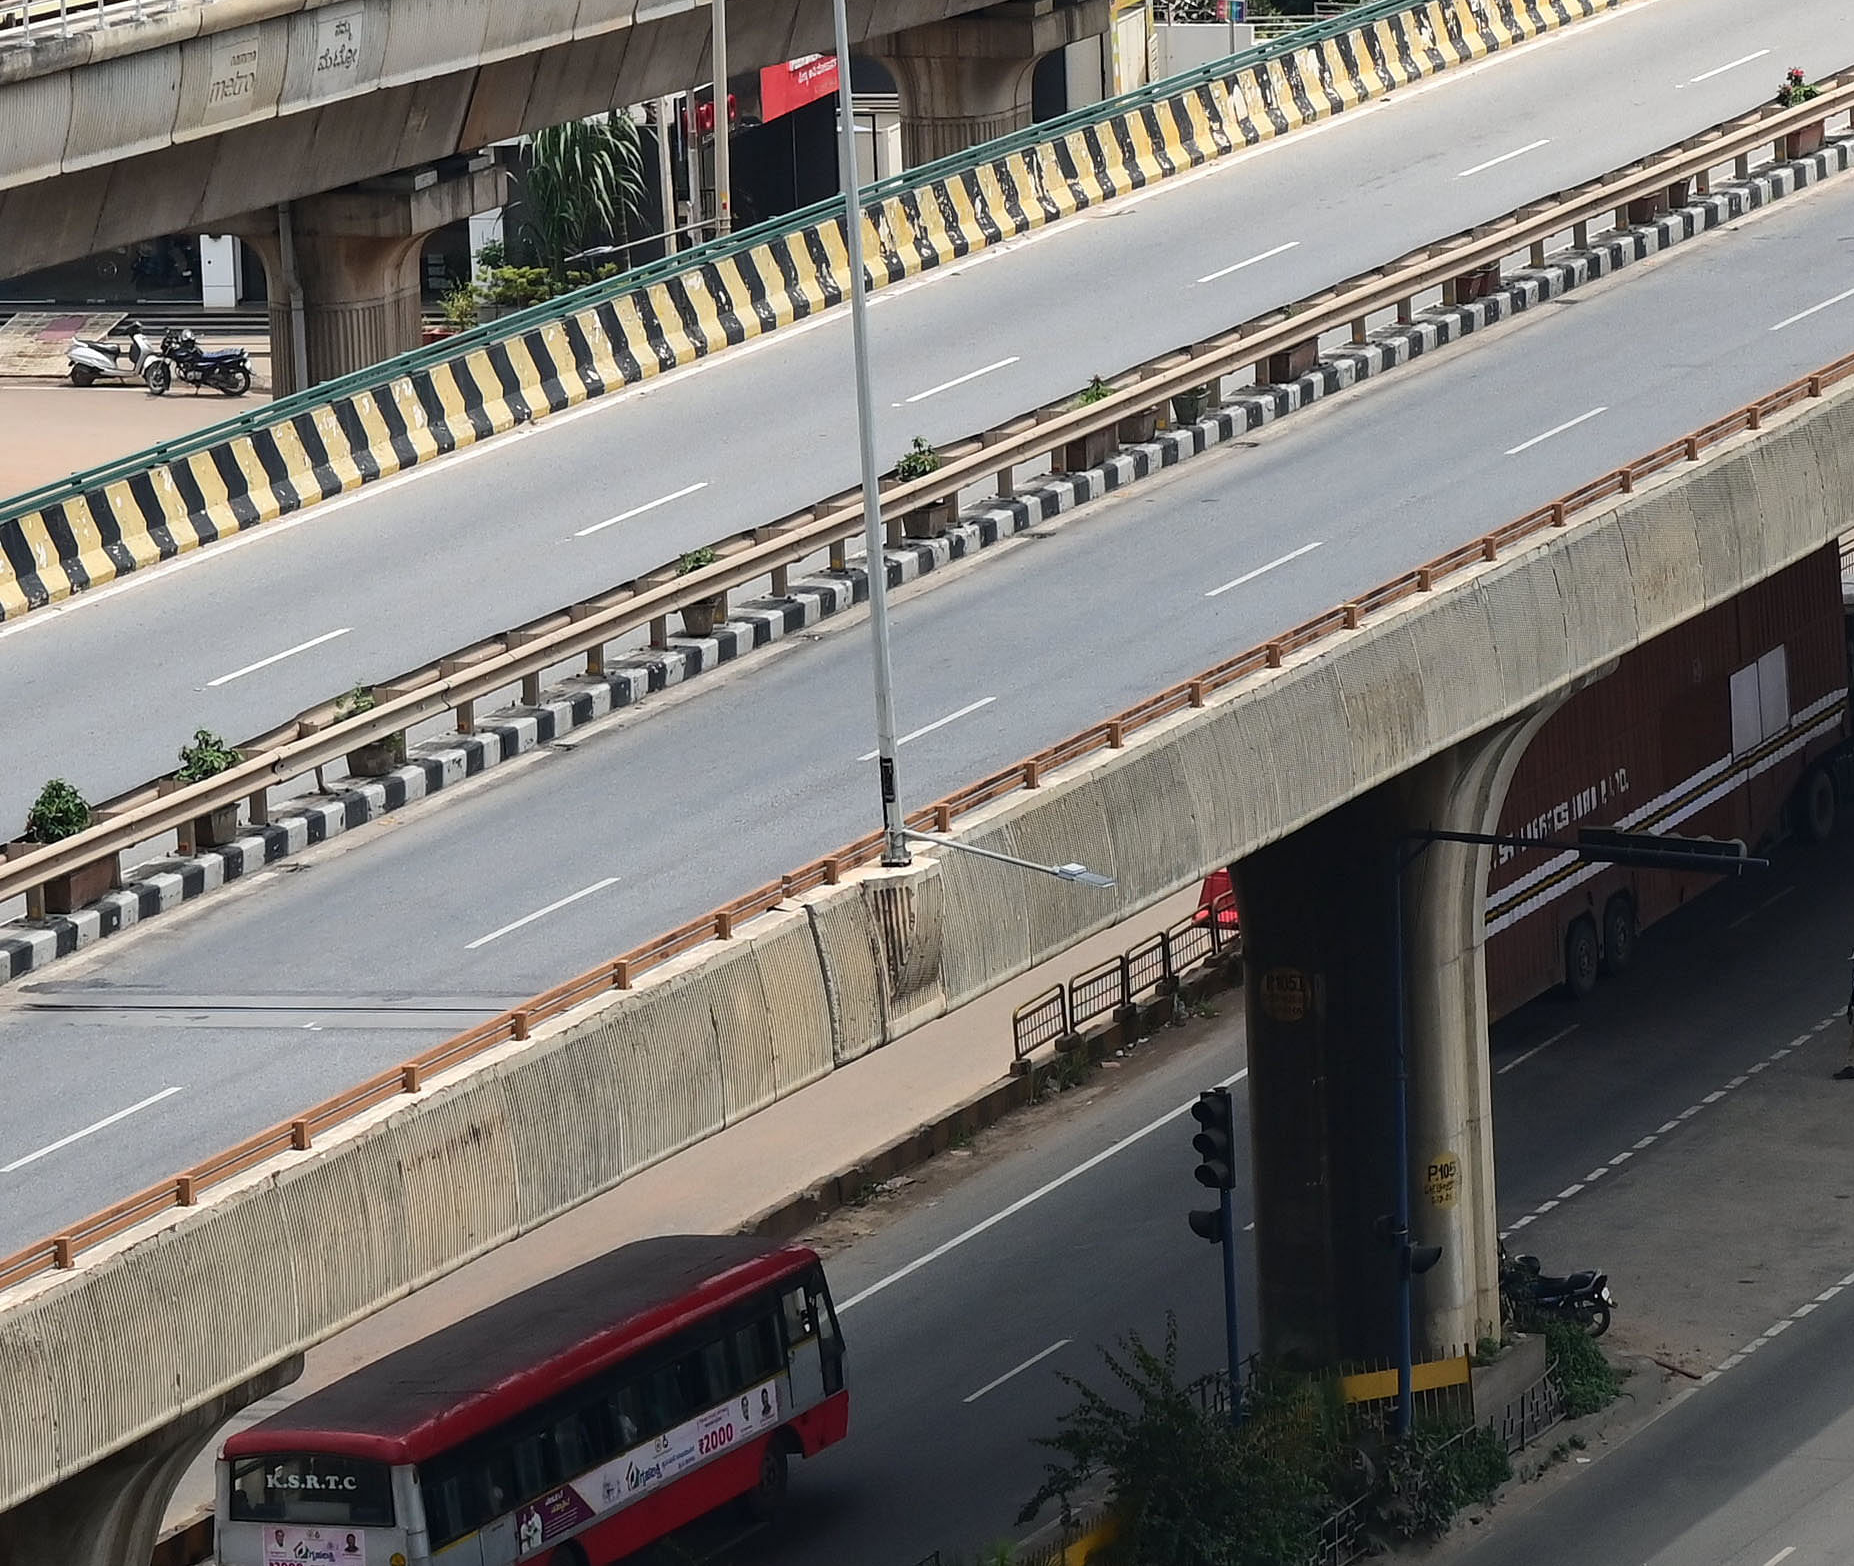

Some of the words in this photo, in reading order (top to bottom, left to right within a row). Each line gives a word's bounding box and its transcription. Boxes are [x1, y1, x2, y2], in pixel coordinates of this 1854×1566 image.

[209, 70, 256, 104] metro
[698, 1422, 734, 1456] ₹2000
[266, 1474, 358, 1490] K.S.R.T.C
